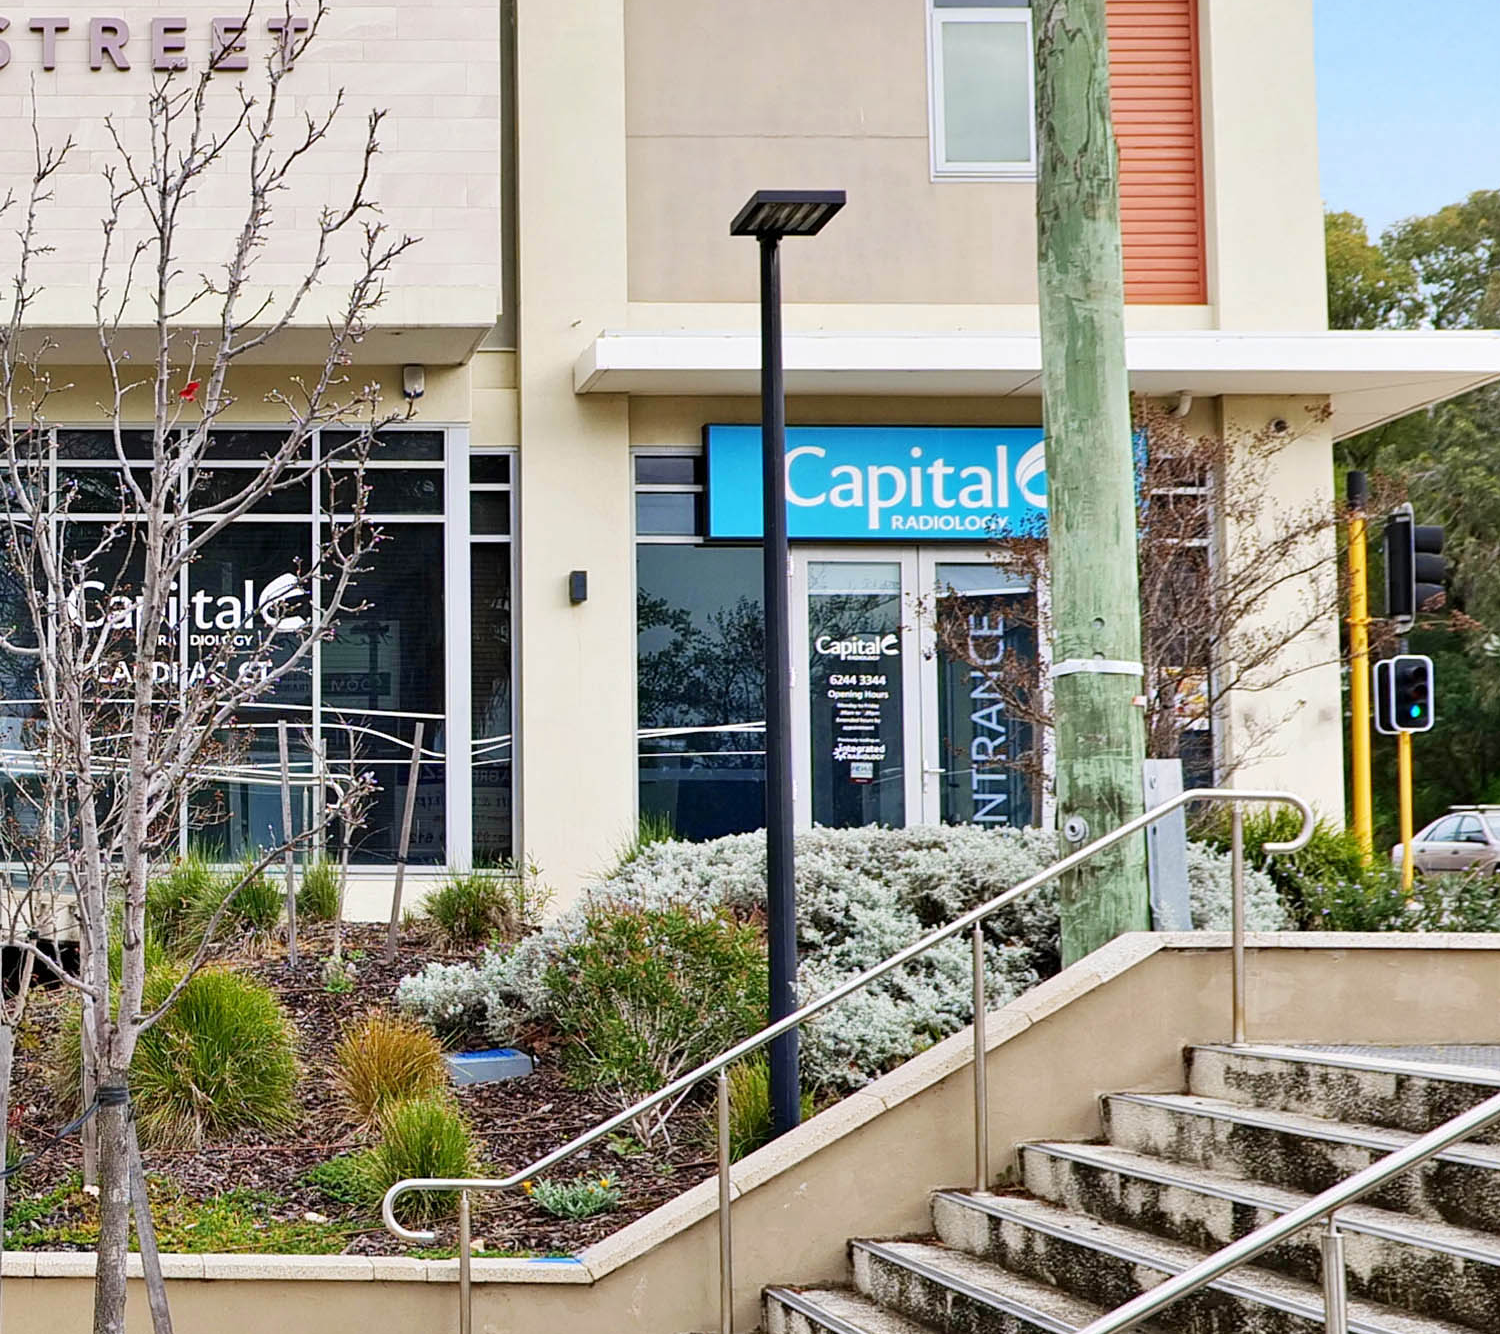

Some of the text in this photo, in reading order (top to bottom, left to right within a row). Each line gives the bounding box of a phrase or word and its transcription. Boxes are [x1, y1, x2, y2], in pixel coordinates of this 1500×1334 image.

[784, 444, 1009, 530] Capital
[891, 515, 1009, 531] RADIOLOGY
[815, 635, 881, 661] Capital
[94, 660, 226, 684] CADIAC
[829, 674, 887, 685] 6244 3344
[827, 689, 889, 700] Opening Hours
[968, 614, 1009, 822] NTRANCE
